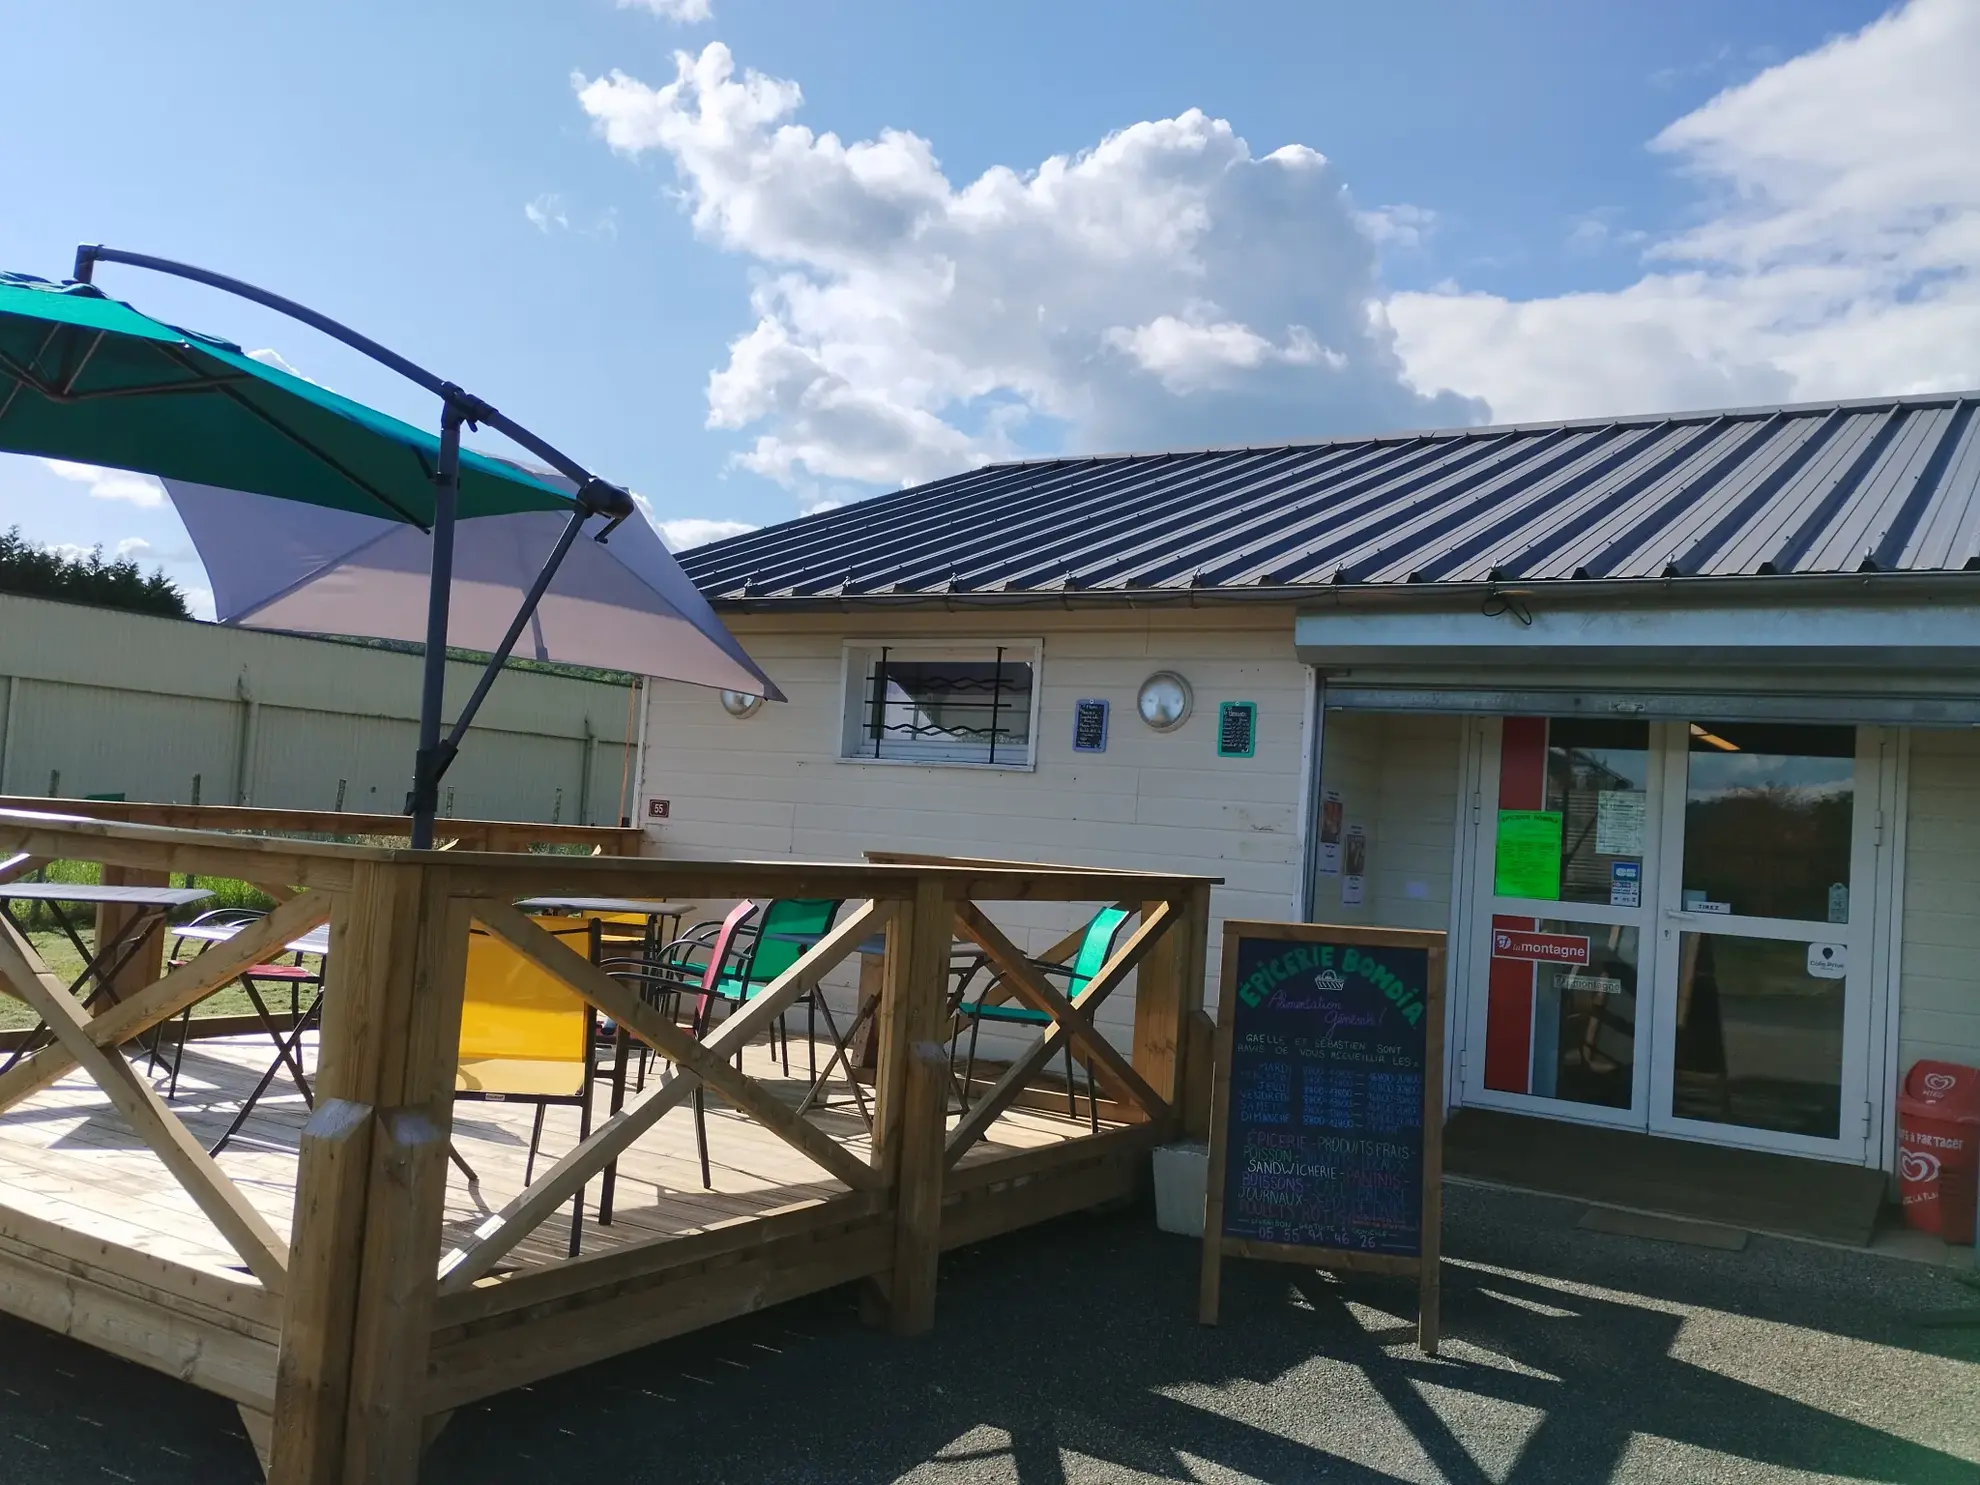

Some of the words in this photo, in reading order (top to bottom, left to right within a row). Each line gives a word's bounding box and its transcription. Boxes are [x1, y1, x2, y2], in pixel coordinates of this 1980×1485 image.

[654, 803, 664, 814] 55
[1268, 989, 1343, 1012] Alimentation
[1237, 1043, 1266, 1054] RAVIS
[1275, 1046, 1289, 1055] DE
[1299, 1048, 1326, 1059] VOUS
[1294, 1036, 1309, 1047] ET
[1376, 1043, 1402, 1055] SONT
[1258, 1062, 1292, 1074] MARDI
[1257, 1081, 1290, 1093] JEUDI
[1240, 1110, 1291, 1123] DIMANCHE
[1243, 1144, 1292, 1162] POISSON
[1317, 1136, 1374, 1156] PRODUITS
[1376, 1143, 1410, 1160] FRAIS
[1247, 1159, 1337, 1180] SANDWICHERIE
[1242, 1170, 1304, 1193] BOISSONS
[1238, 1186, 1303, 1206] JOURNAUX
[1258, 1226, 1275, 1240] 05
[1283, 1228, 1300, 1243] 55
[1334, 1232, 1350, 1246] 46
[1360, 1235, 1376, 1249] 26
